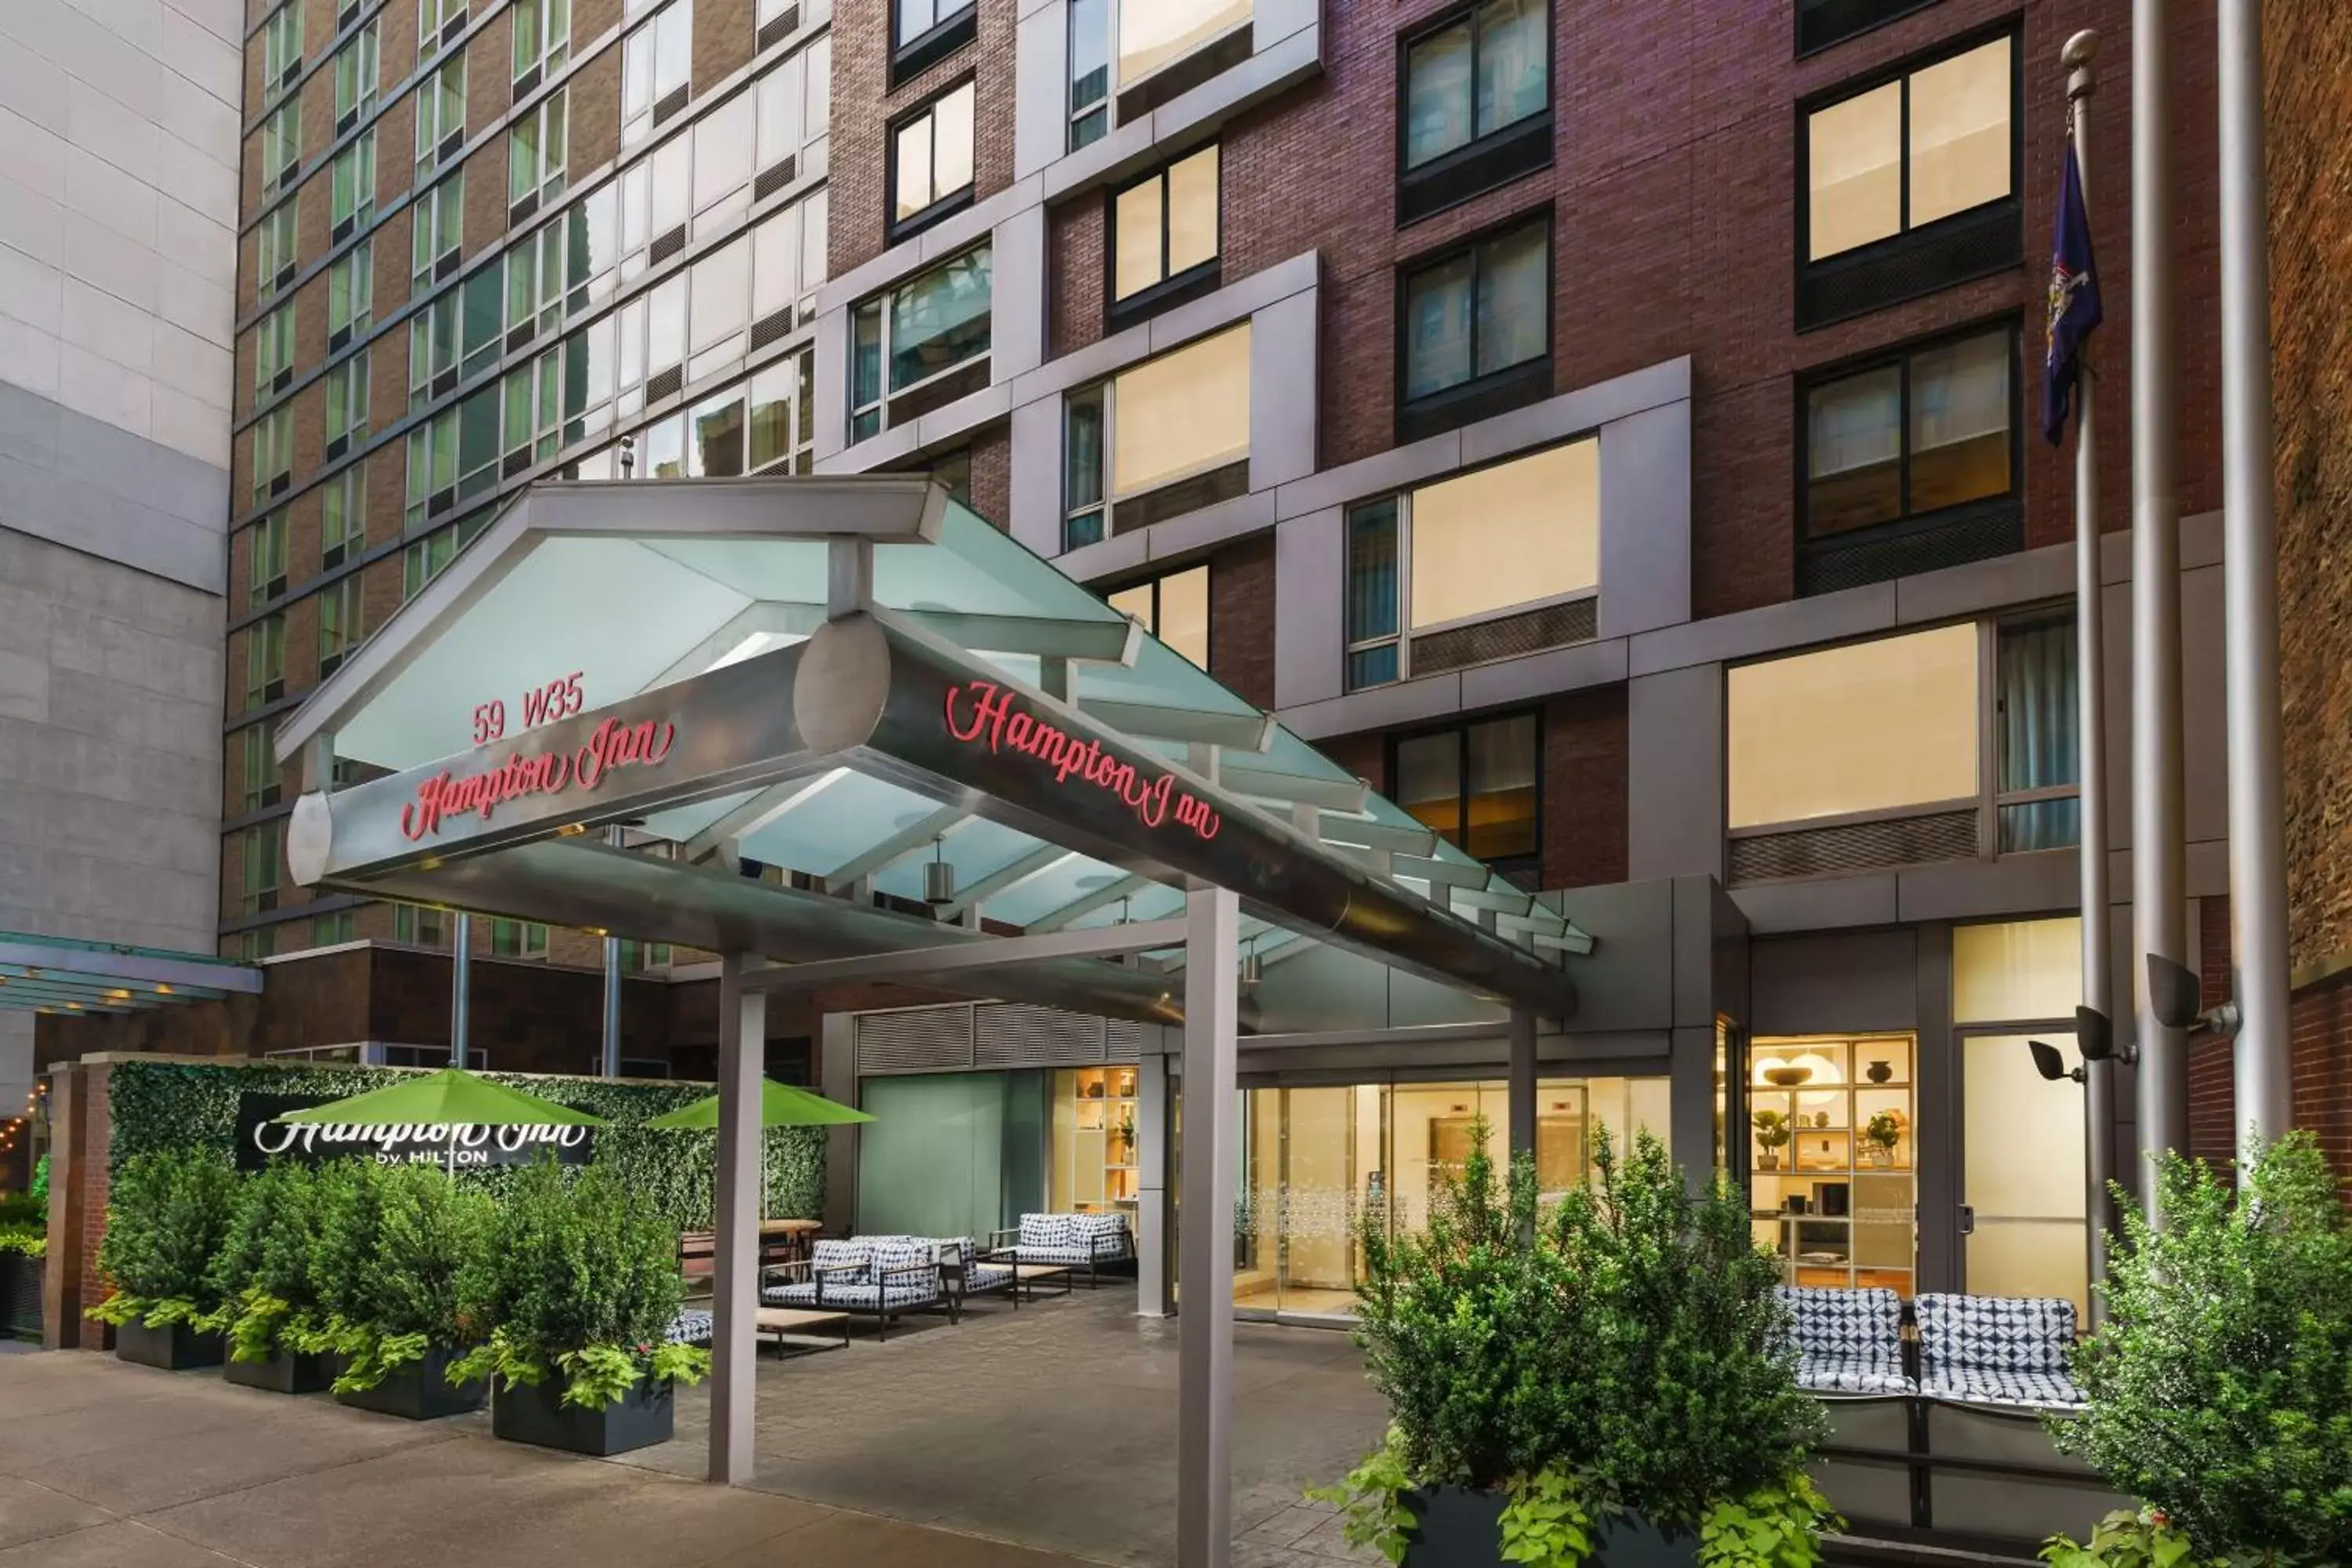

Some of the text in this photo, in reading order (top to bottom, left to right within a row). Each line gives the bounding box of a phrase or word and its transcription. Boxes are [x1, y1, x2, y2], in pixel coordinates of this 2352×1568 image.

[474, 671, 583, 745] 59 W35
[401, 717, 674, 841] Hampton Inn
[946, 681, 1220, 840] Hampton Inn
[376, 1151, 401, 1167] by
